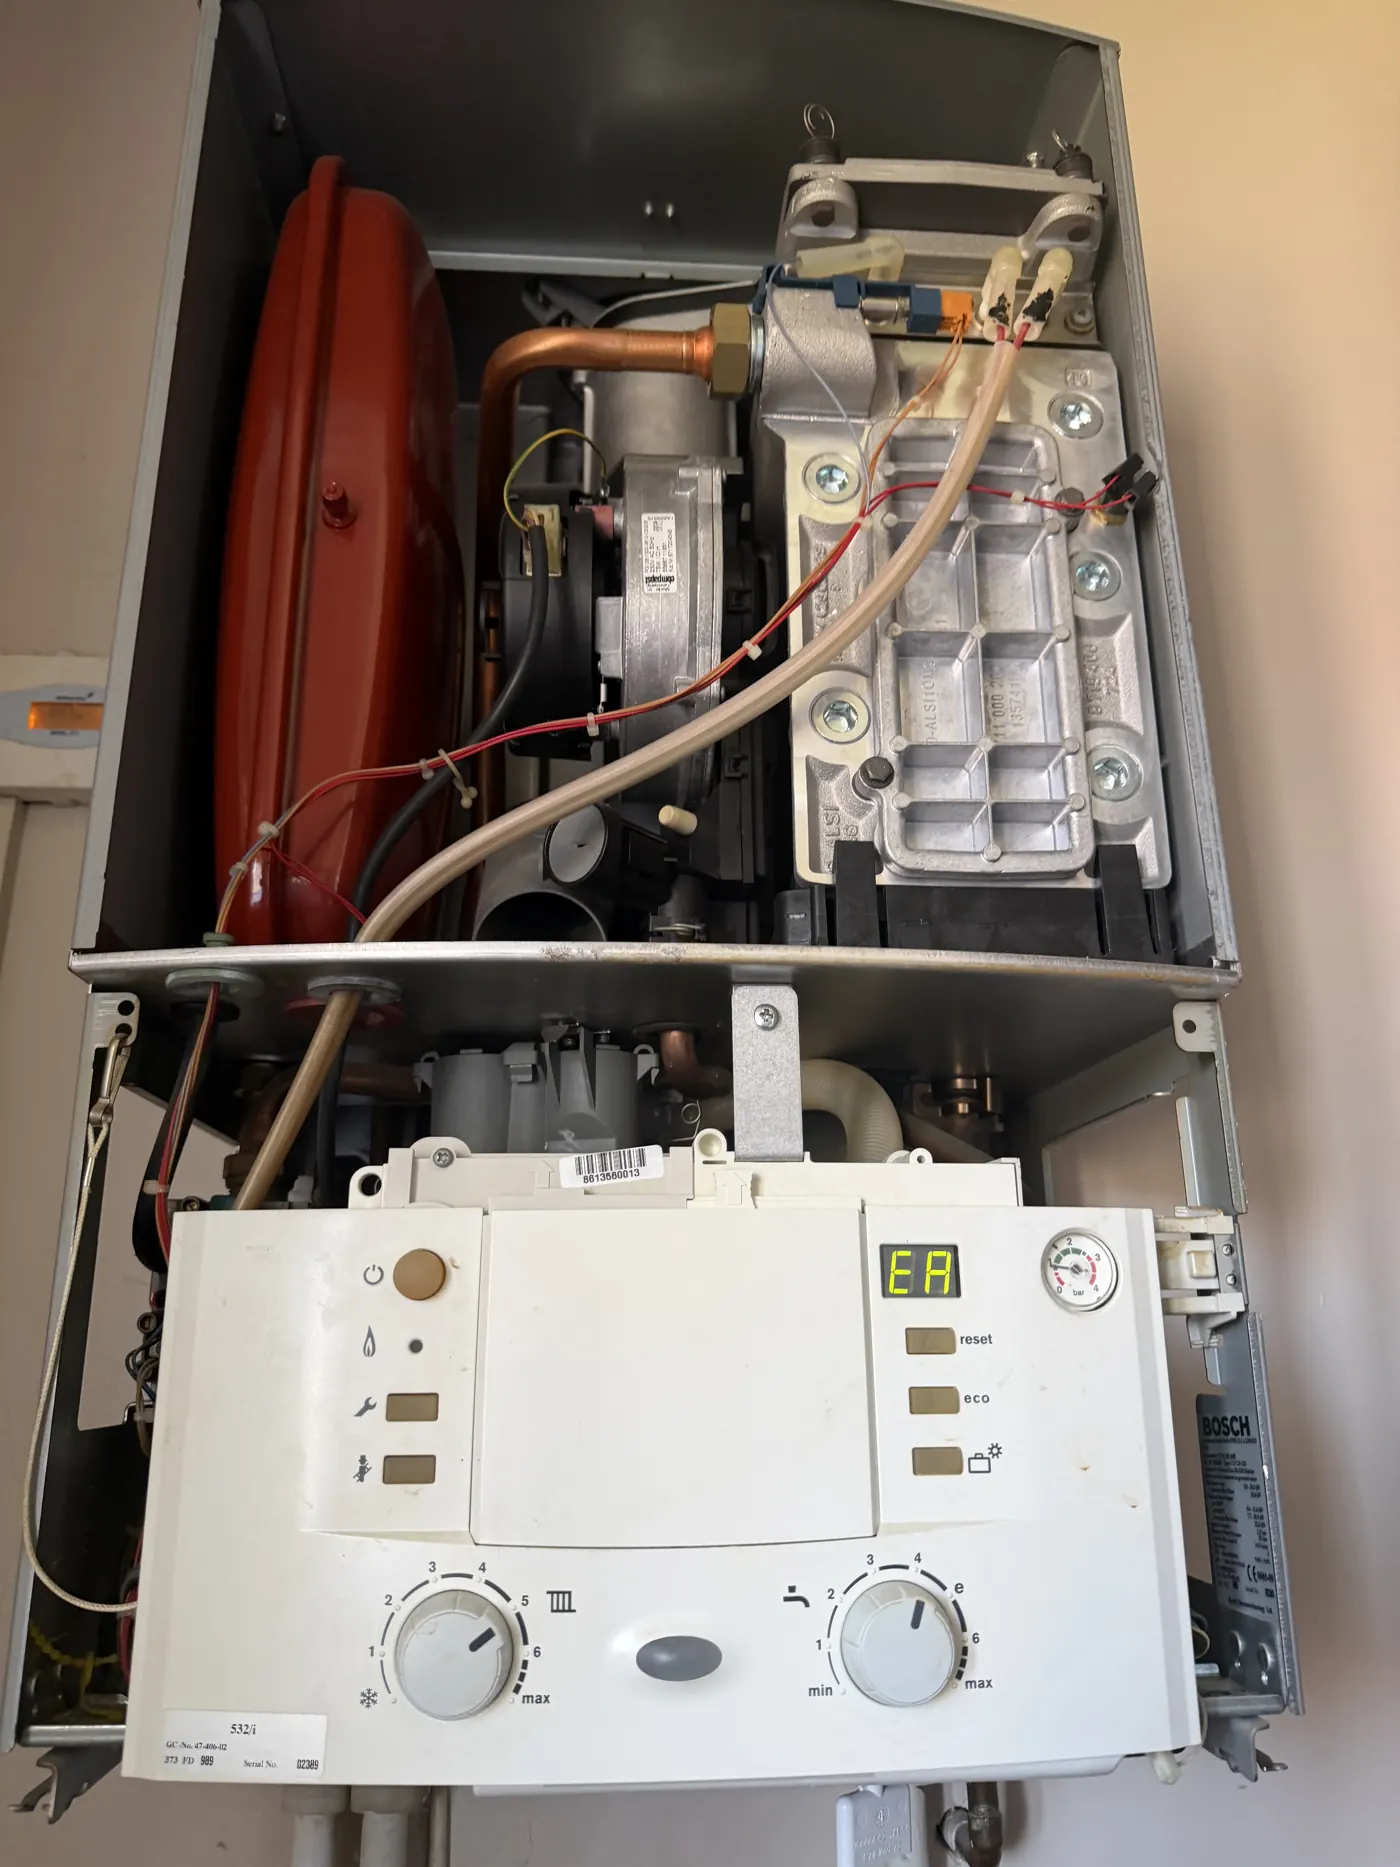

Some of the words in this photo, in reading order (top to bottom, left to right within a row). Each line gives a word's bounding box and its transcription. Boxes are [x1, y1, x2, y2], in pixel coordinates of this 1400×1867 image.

[1066, 1237, 1073, 1246] 2
[1094, 1253, 1101, 1262] 3
[888, 1250, 952, 1295] EA
[1056, 1285, 1063, 1294] 0
[1072, 1288, 1085, 1296] bar
[1093, 1284, 1100, 1293] 4
[960, 1333, 993, 1345] reset
[964, 1393, 990, 1404] eco
[1201, 1415, 1251, 1437] BOSCH
[866, 1554, 874, 1566] 3
[914, 1552, 922, 1564] 4
[428, 1561, 437, 1573] 3
[478, 1562, 487, 1573] 4
[827, 1588, 835, 1600] 2
[954, 1582, 965, 1594] e
[384, 1594, 393, 1606] 2
[521, 1596, 529, 1607] 5
[815, 1638, 822, 1650] 1
[972, 1632, 980, 1644] 6
[368, 1646, 375, 1657] 1
[533, 1646, 542, 1658] 6
[965, 1678, 993, 1690] max
[808, 1684, 833, 1697] min
[521, 1694, 551, 1704] max
[230, 1723, 257, 1736] 532/i
[166, 1741, 178, 1749] GC
[164, 1755, 178, 1764] 373
[182, 1756, 195, 1765] FD
[243, 1759, 264, 1768] Serial
[265, 1760, 278, 1769] No.
